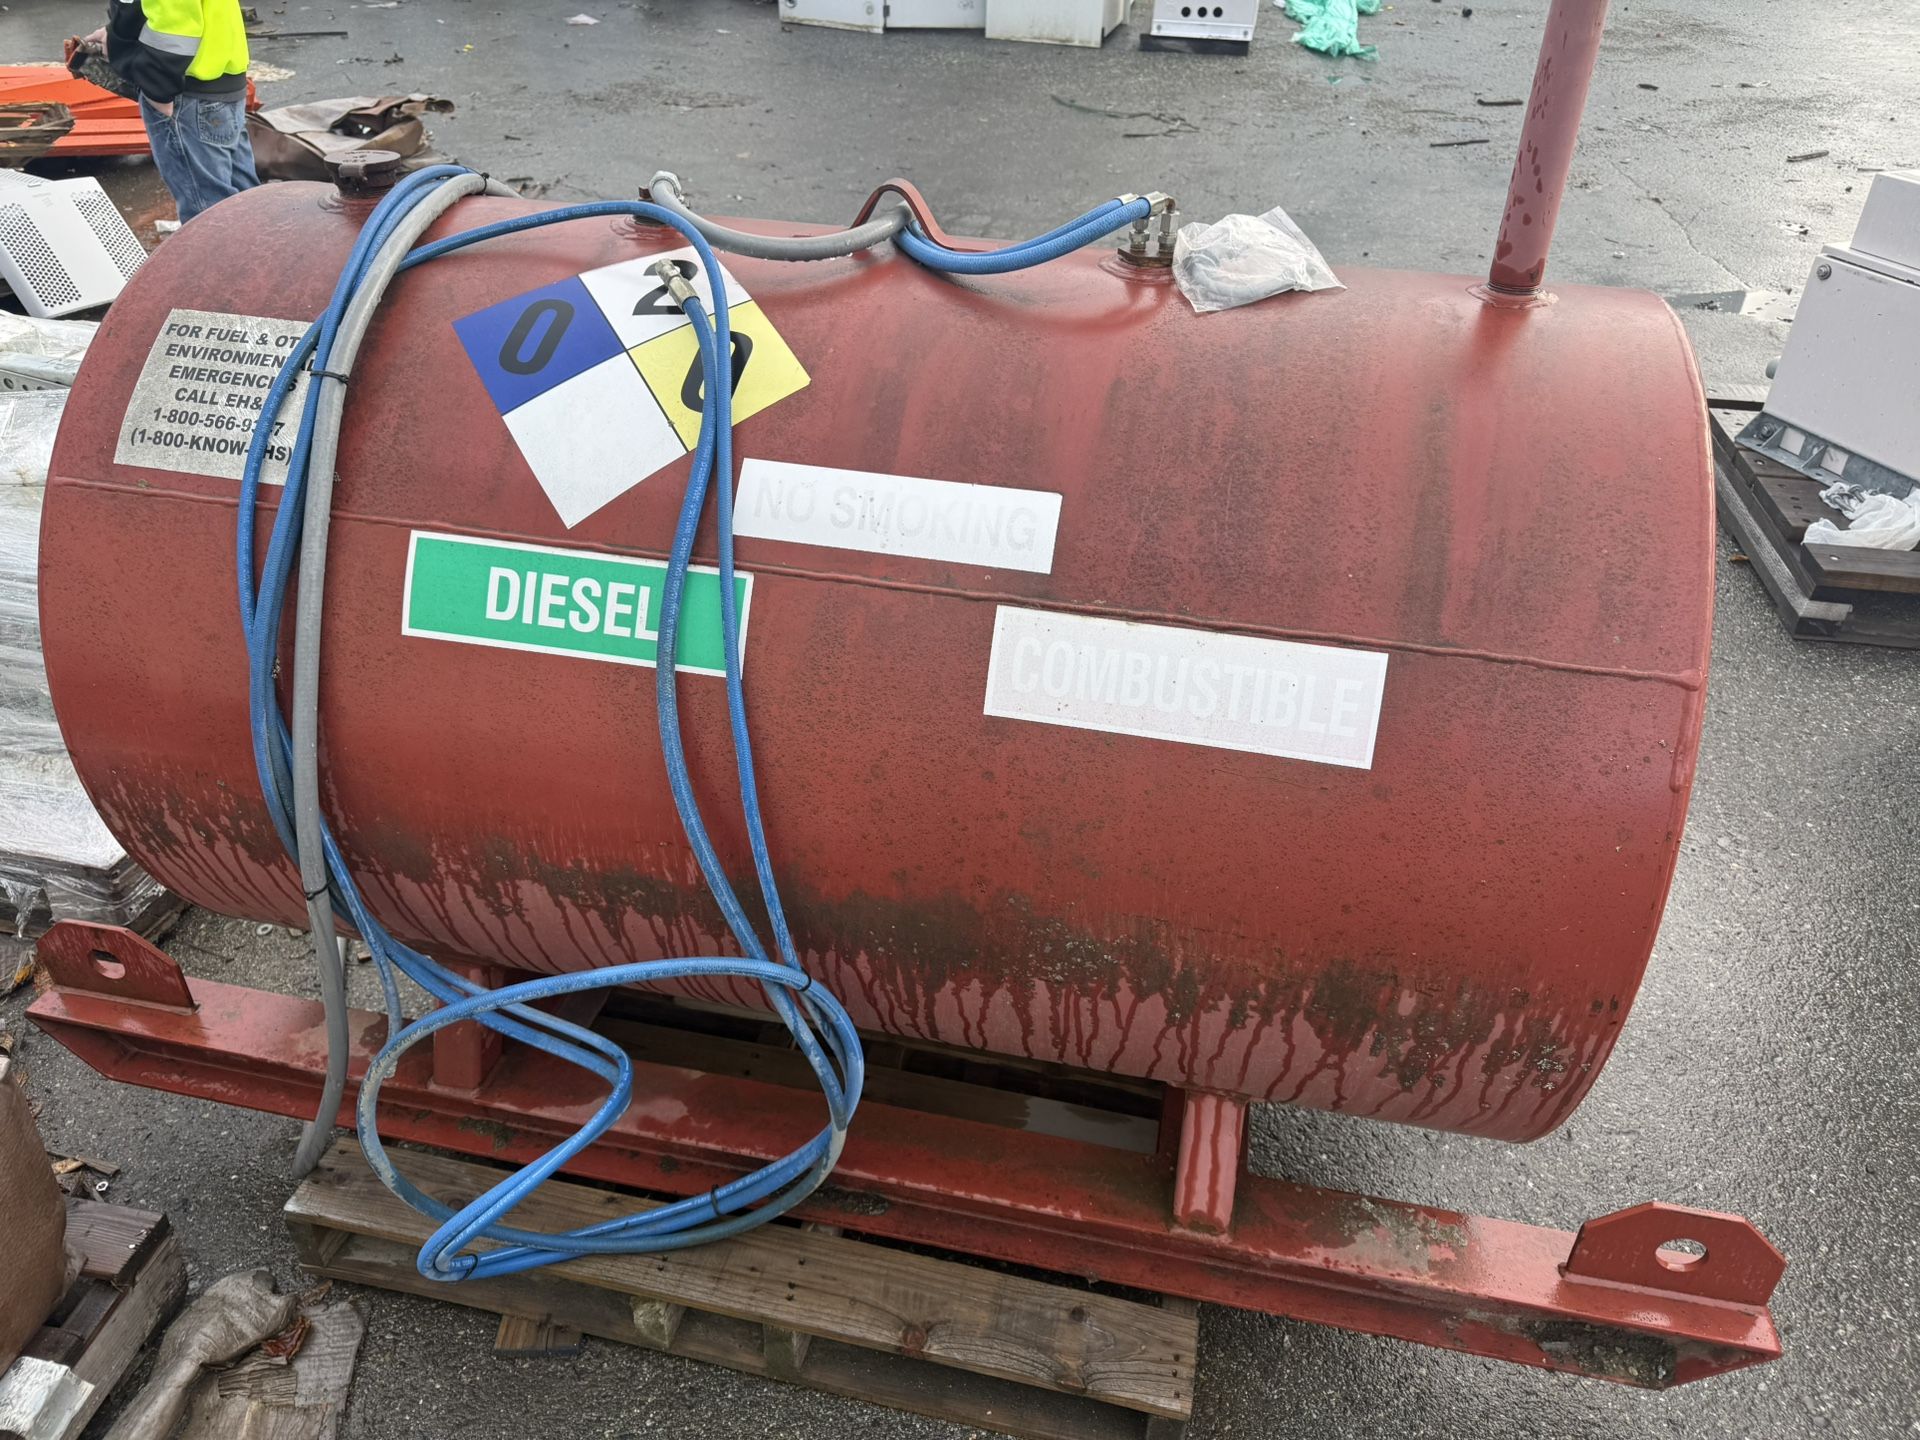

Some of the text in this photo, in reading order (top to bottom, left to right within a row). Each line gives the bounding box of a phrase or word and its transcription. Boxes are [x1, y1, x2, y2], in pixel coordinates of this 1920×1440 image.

[165, 323, 202, 340] FOR
[205, 327, 250, 344] FUEL
[256, 333, 269, 346] &
[498, 298, 576, 376] 0
[168, 365, 298, 393] EMERGENCIS
[174, 387, 263, 411] CALL EH&
[152, 407, 286, 437] 1-800-566-97
[131, 427, 293, 466] (1-800-KNOW-HS)
[754, 475, 1039, 553] NO SMOKING
[485, 566, 659, 641] DIESEL
[1010, 635, 1365, 738] COMBUSTIBLE
